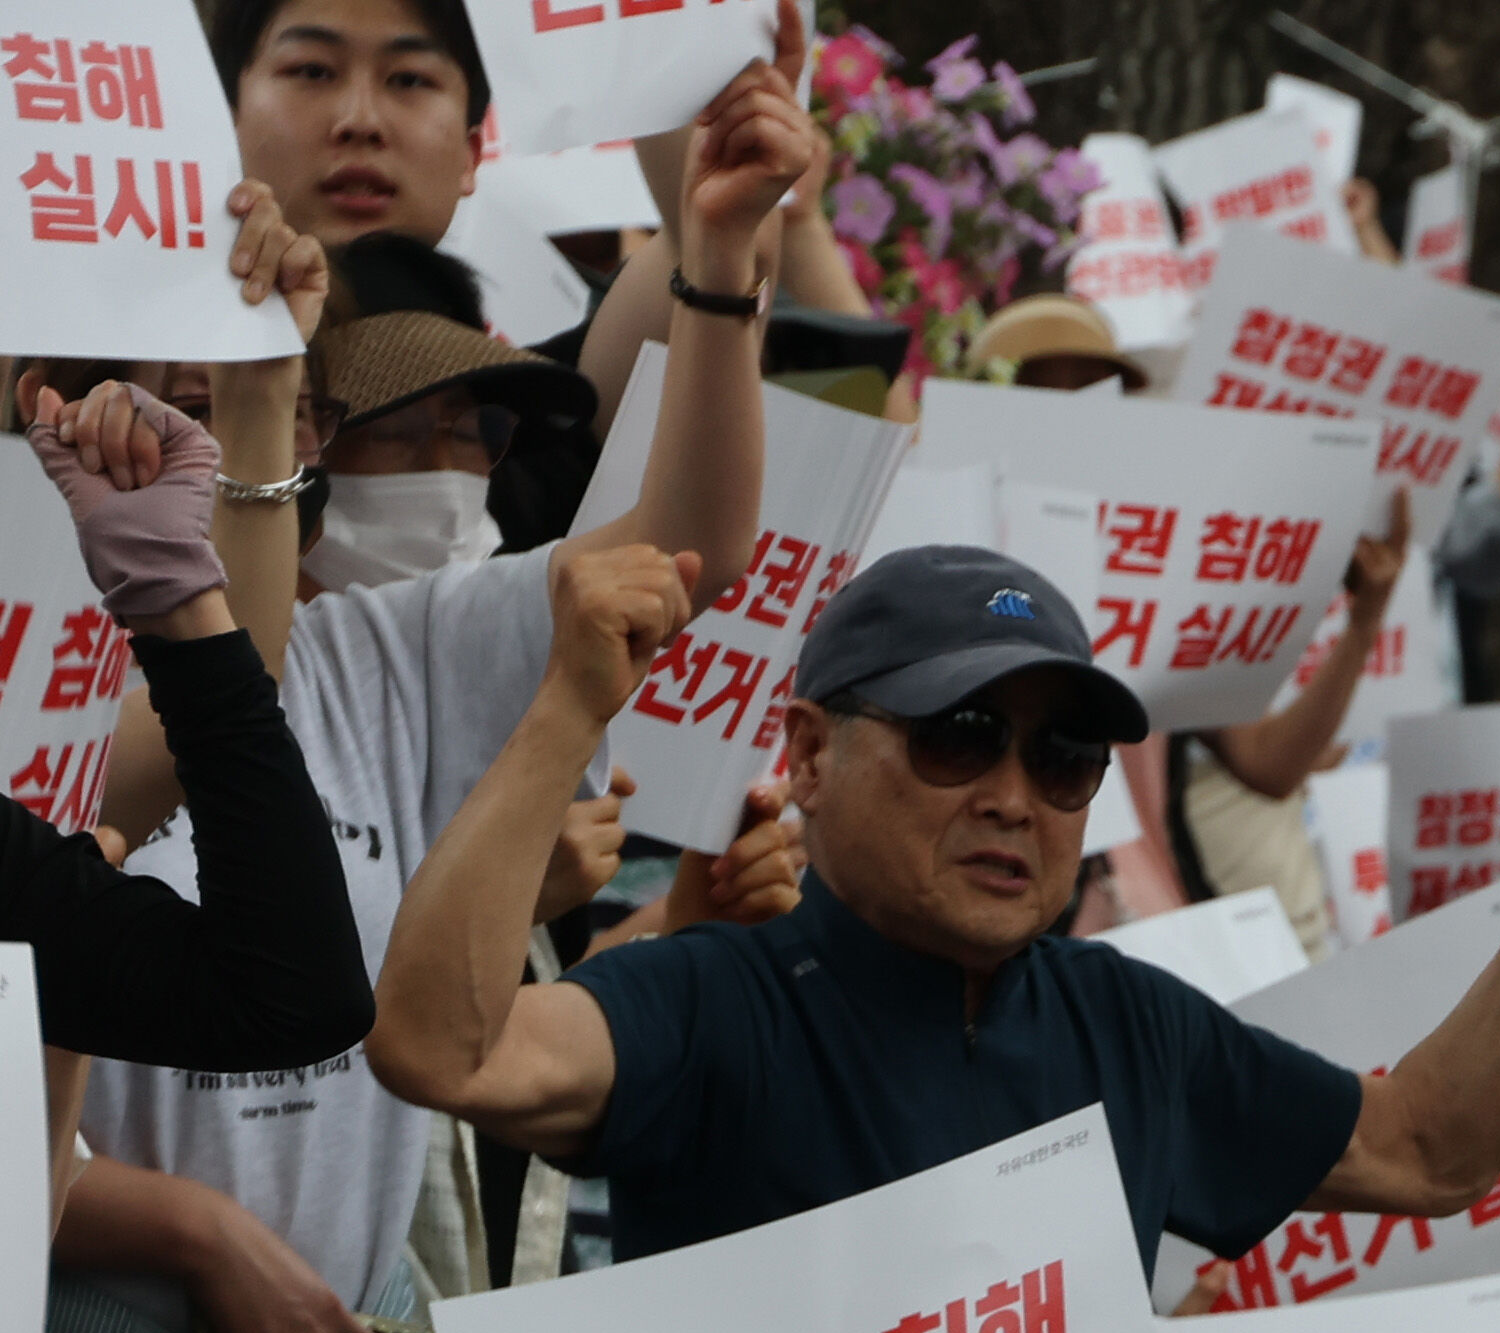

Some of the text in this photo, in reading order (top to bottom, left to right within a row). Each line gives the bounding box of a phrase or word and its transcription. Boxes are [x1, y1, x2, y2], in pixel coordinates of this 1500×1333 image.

[2, 34, 164, 129] 침해
[21, 153, 205, 249] 실시!
[1230, 309, 1479, 419] 참정권 침해
[1378, 427, 1460, 483] 시!
[1197, 514, 1319, 583] 침해
[1171, 606, 1300, 669] 실시!
[634, 636, 768, 746] 선거
[996, 1130, 1090, 1176] 자유대한호국단
